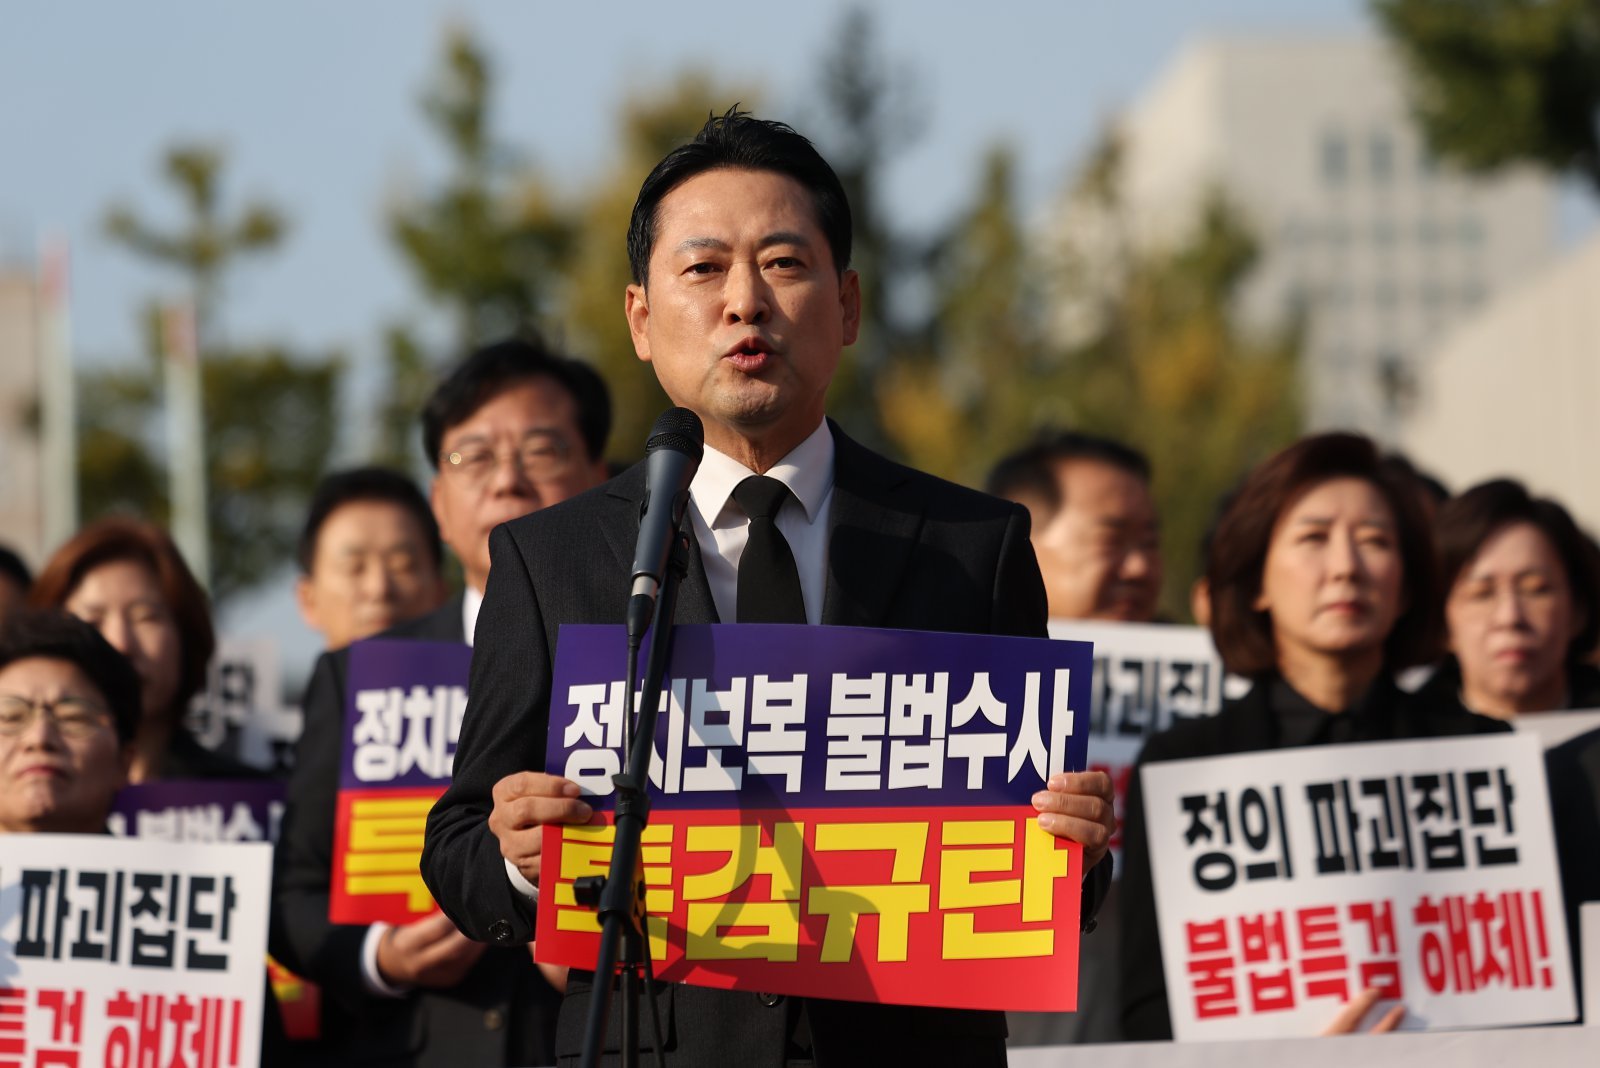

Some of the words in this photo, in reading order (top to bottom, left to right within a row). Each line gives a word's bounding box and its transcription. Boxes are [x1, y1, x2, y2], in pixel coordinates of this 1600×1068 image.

[825, 667, 1074, 791] 불법수사
[554, 817, 1069, 964] 특검규탄
[1178, 784, 1294, 894] 정의
[1304, 767, 1520, 875] 파괴집단
[14, 868, 237, 972] 파괴집단
[1182, 900, 1404, 1021] 불법특검
[1413, 889, 1555, 996] 해체!
